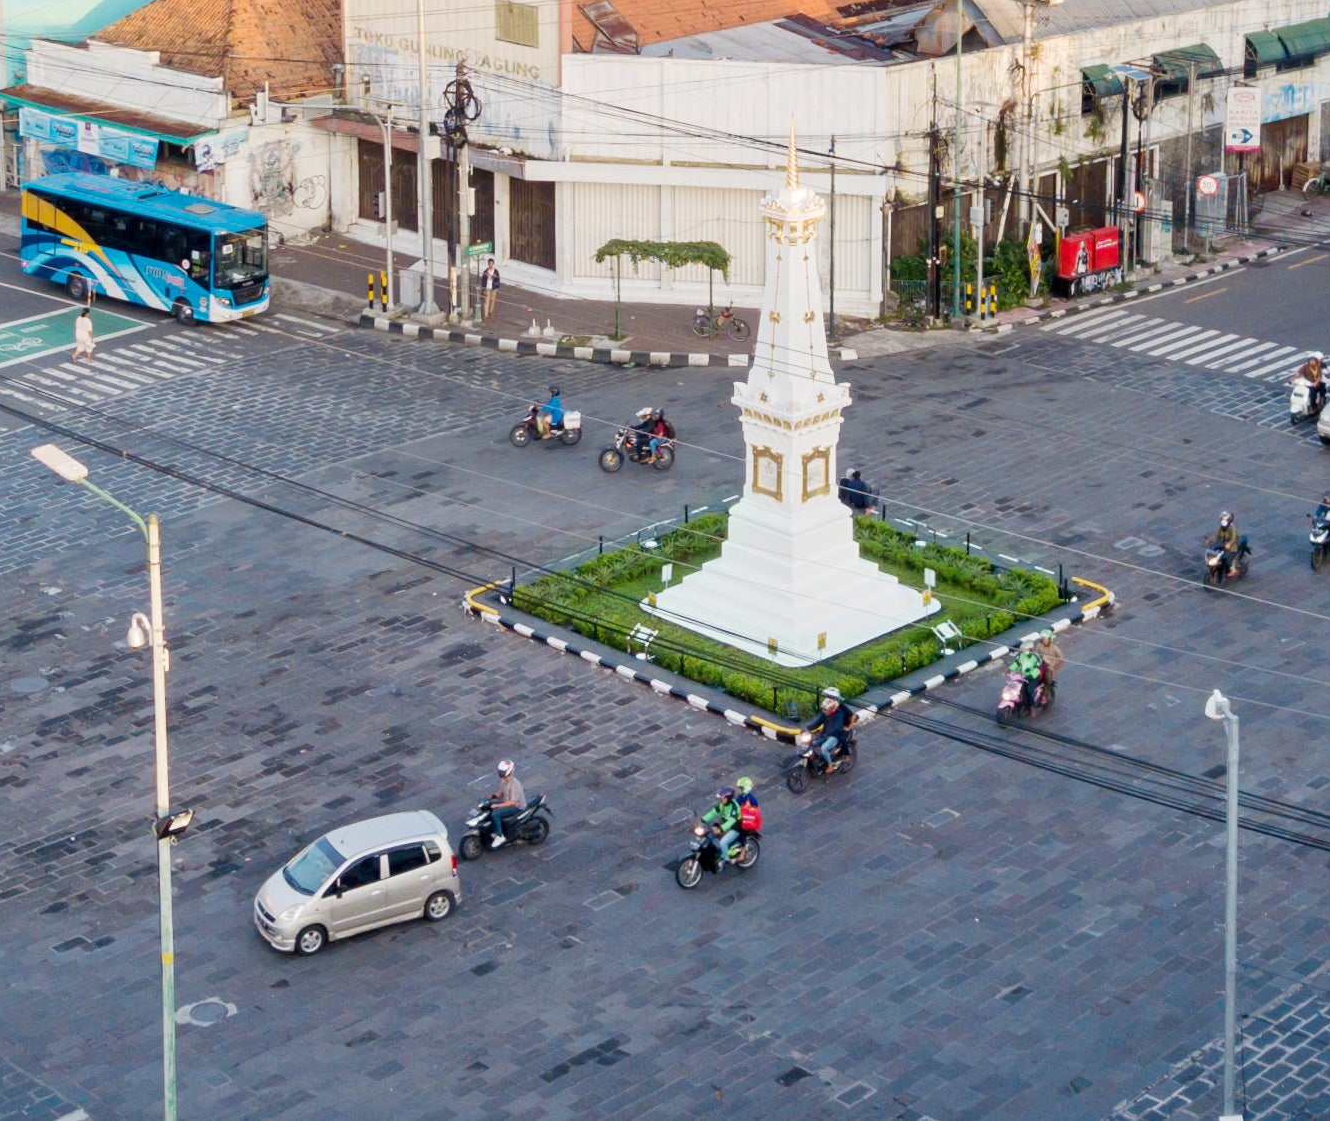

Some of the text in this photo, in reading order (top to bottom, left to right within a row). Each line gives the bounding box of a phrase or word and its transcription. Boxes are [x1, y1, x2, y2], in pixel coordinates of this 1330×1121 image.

[353, 26, 540, 79] TOKO GUNUNG AGUNG
